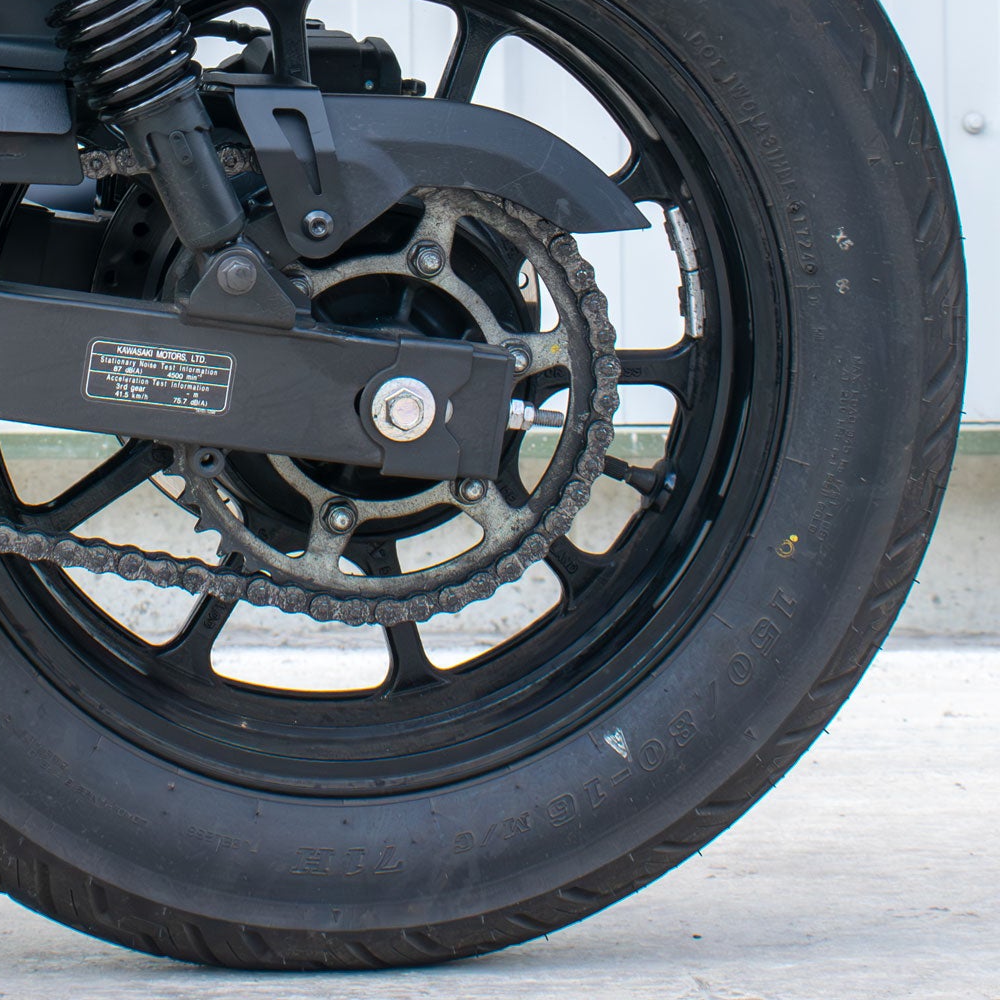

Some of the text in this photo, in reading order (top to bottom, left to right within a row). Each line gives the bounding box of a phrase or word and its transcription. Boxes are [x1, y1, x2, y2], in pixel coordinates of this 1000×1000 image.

[685, 30, 724, 67] DOT
[117, 346, 153, 358] KAWASAKI
[191, 354, 207, 364] LTD.
[100, 355, 136, 368] Stationary
[140, 360, 157, 369] Noise
[161, 362, 176, 371] Test
[124, 366, 143, 375] dB(A)
[167, 372, 184, 380] 4500
[106, 374, 149, 386] Acceleration
[152, 379, 168, 388] Test
[116, 382, 128, 391] 3rd
[114, 390, 148, 400] 41.5 km/h
[190, 398, 208, 407] dB(A)
[547, 588, 797, 827] 150/80-16
[290, 845, 402, 876] 71H
